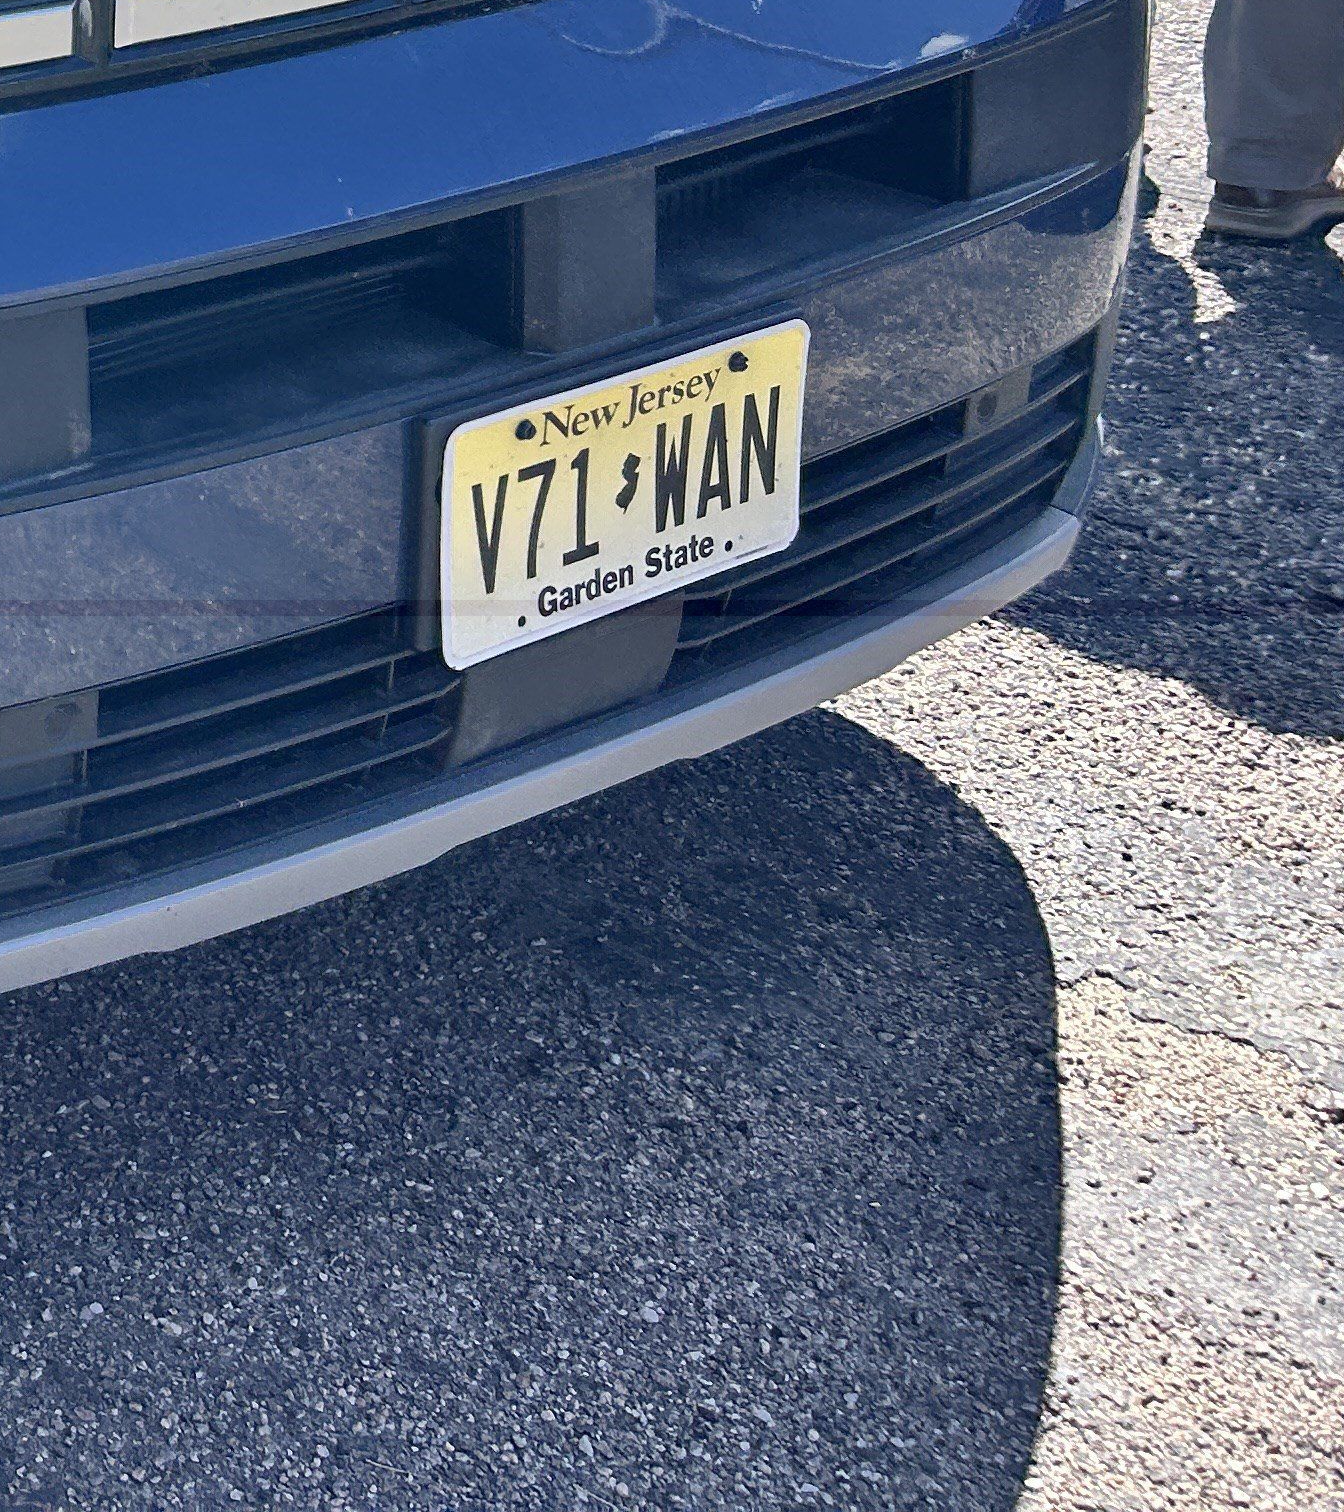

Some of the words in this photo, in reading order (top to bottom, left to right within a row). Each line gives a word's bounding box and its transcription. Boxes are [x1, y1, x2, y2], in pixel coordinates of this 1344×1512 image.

[539, 401, 621, 447] New
[622, 367, 722, 428] Jersey
[470, 447, 600, 595] V71
[654, 384, 782, 534] WAN
[537, 563, 634, 618] Garden
[645, 534, 715, 578] State
